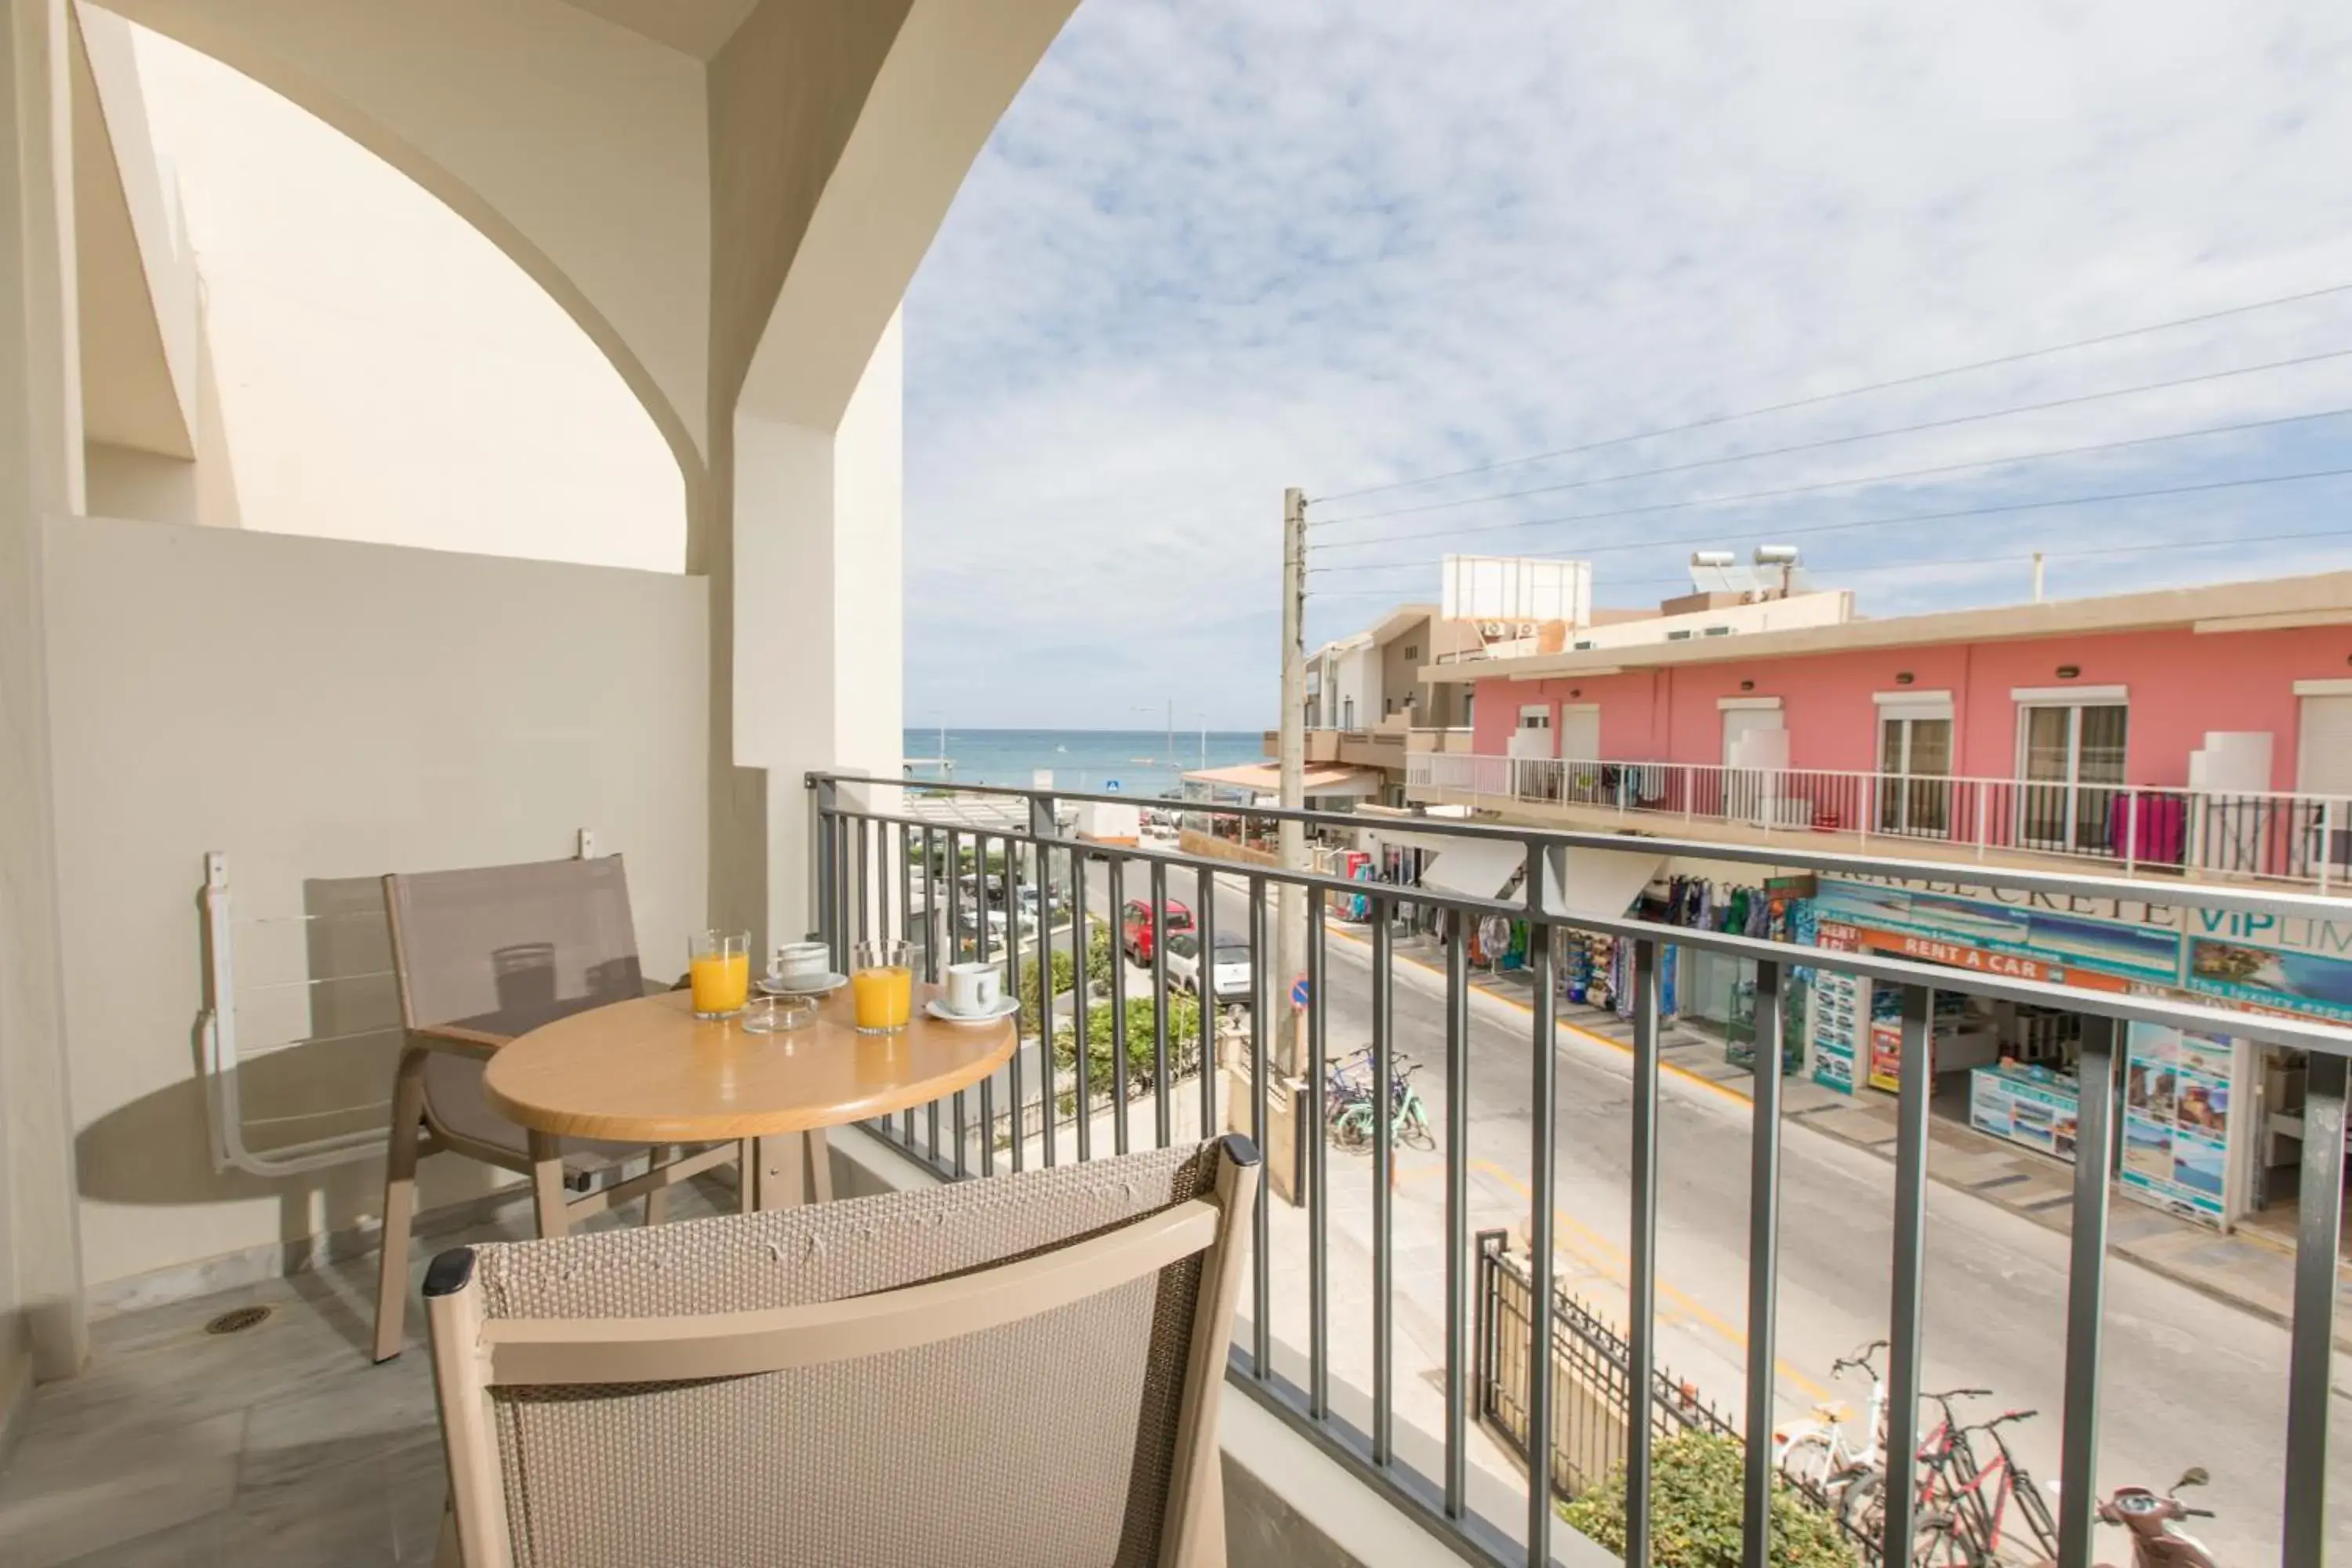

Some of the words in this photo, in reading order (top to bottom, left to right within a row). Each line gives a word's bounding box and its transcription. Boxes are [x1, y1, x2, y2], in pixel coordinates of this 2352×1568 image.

[1906, 938, 1959, 960] RENT
[1967, 951, 1980, 967] A
[1988, 955, 2037, 978] CAR
